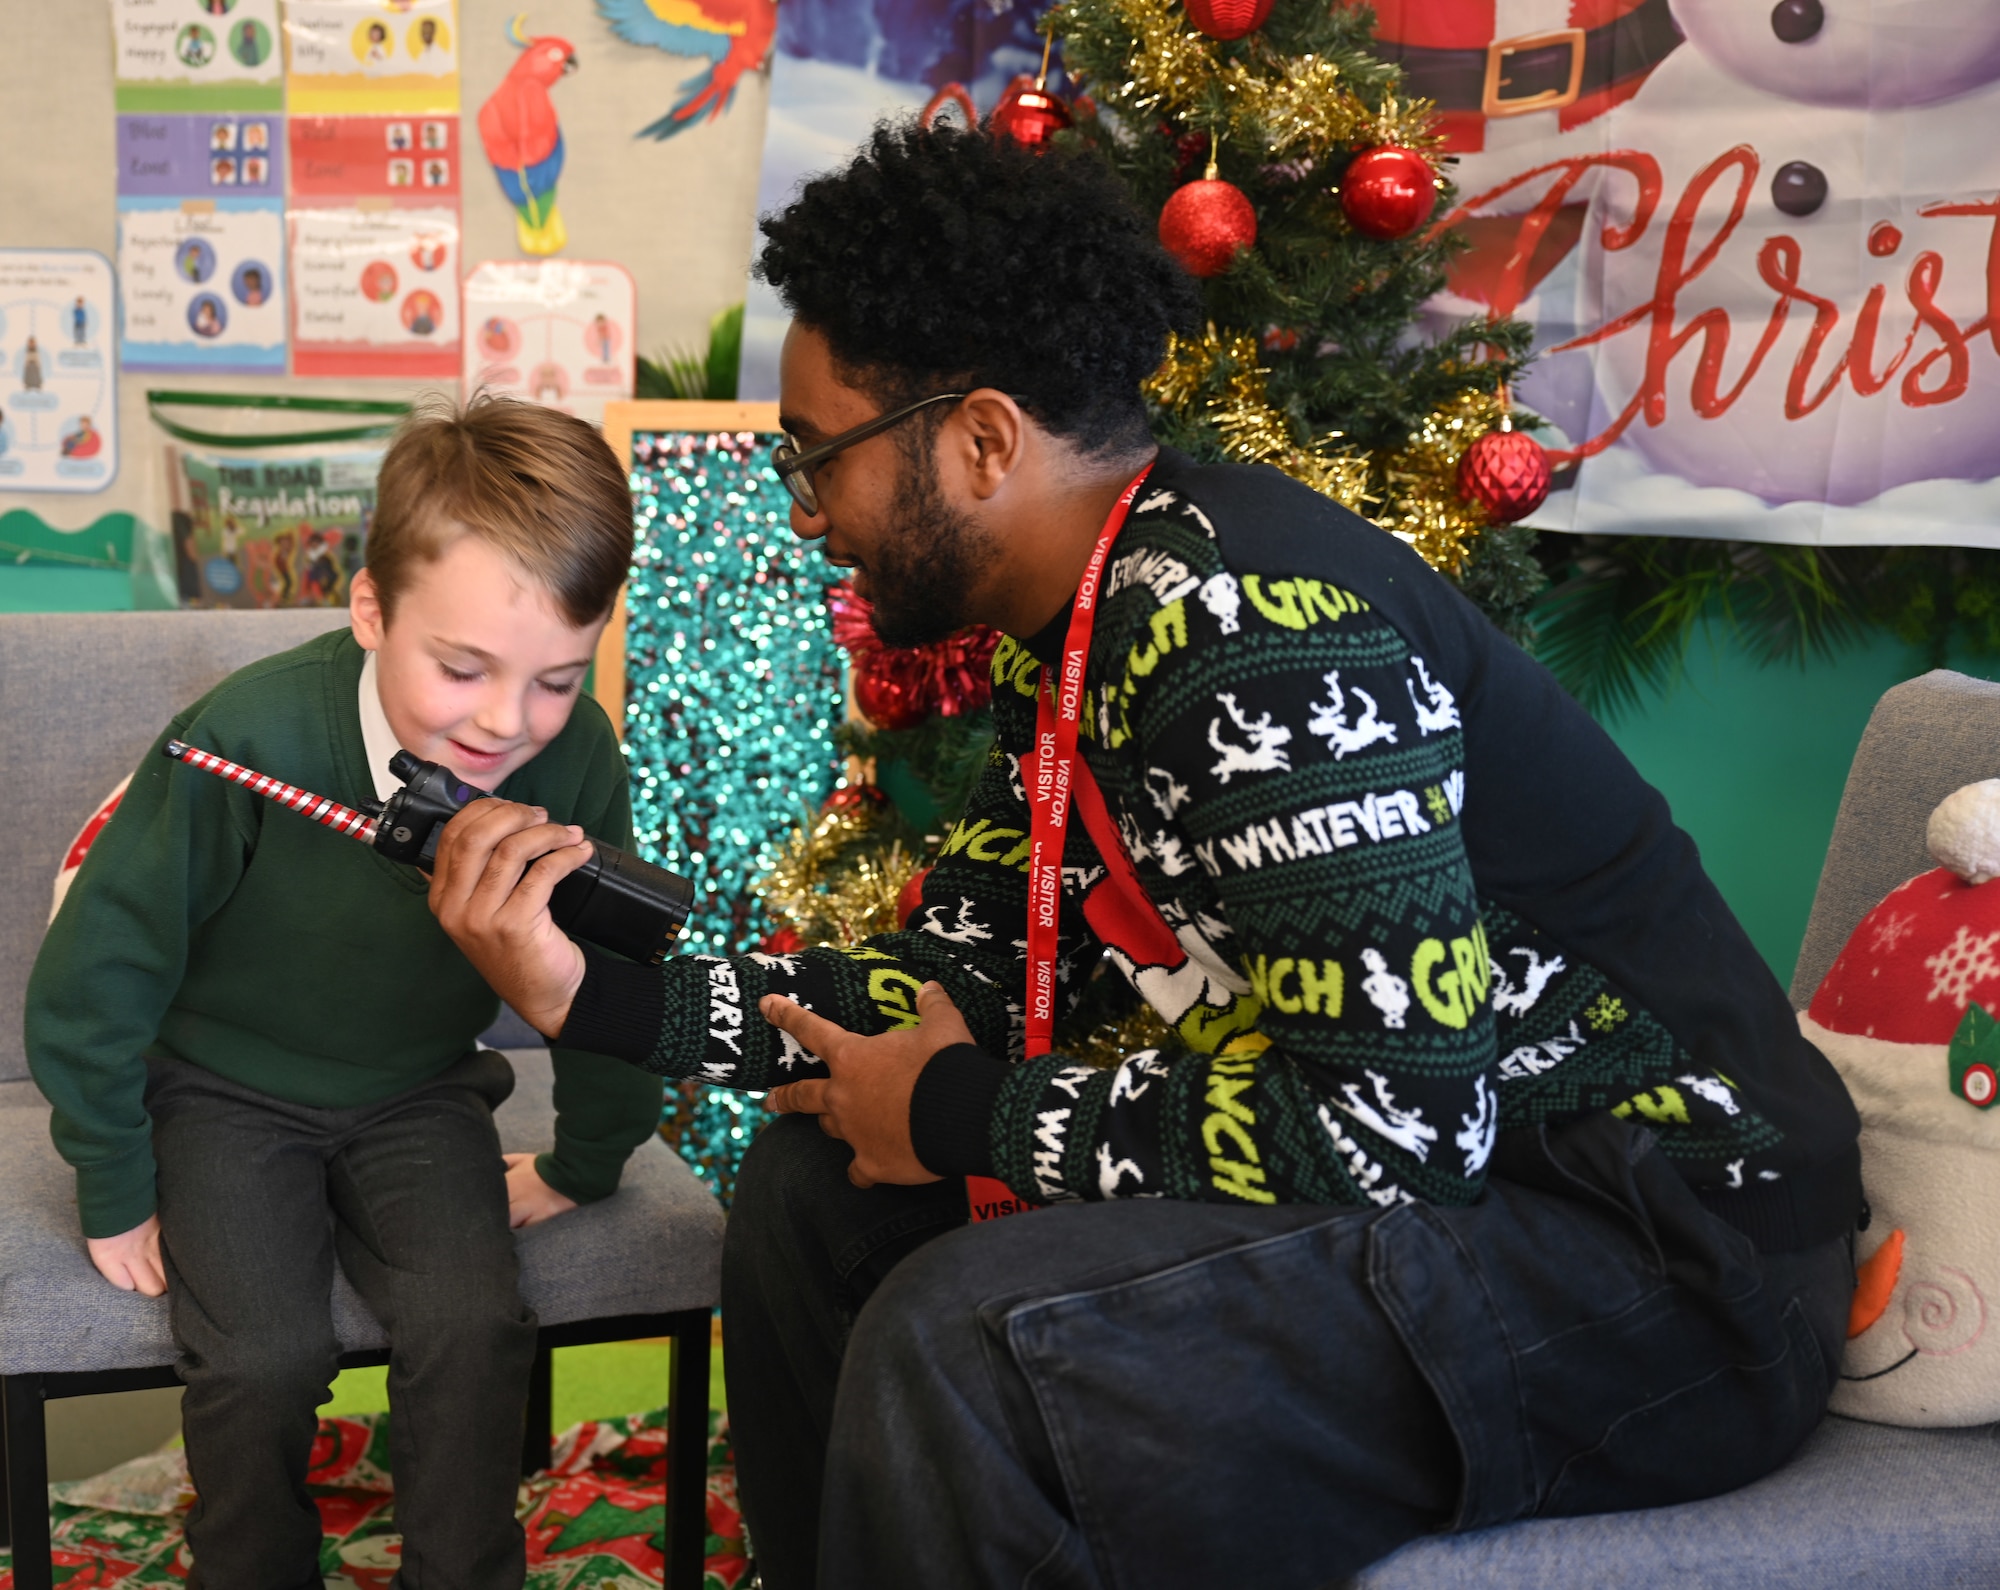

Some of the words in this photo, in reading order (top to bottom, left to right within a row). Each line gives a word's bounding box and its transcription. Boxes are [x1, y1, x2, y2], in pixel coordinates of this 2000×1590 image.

[218, 465, 256, 488] THE
[263, 464, 322, 487] ROAD
[218, 487, 362, 528] Regulation
[1077, 536, 1109, 610] VISITOR
[1061, 649, 1084, 721] VISITOR
[1036, 732, 1056, 802] VISITOR
[1049, 759, 1071, 828] VISITOR
[1220, 790, 1431, 870] WHATEVER
[1038, 865, 1056, 928] VISITOR
[1034, 960, 1051, 1020] VISITOR
